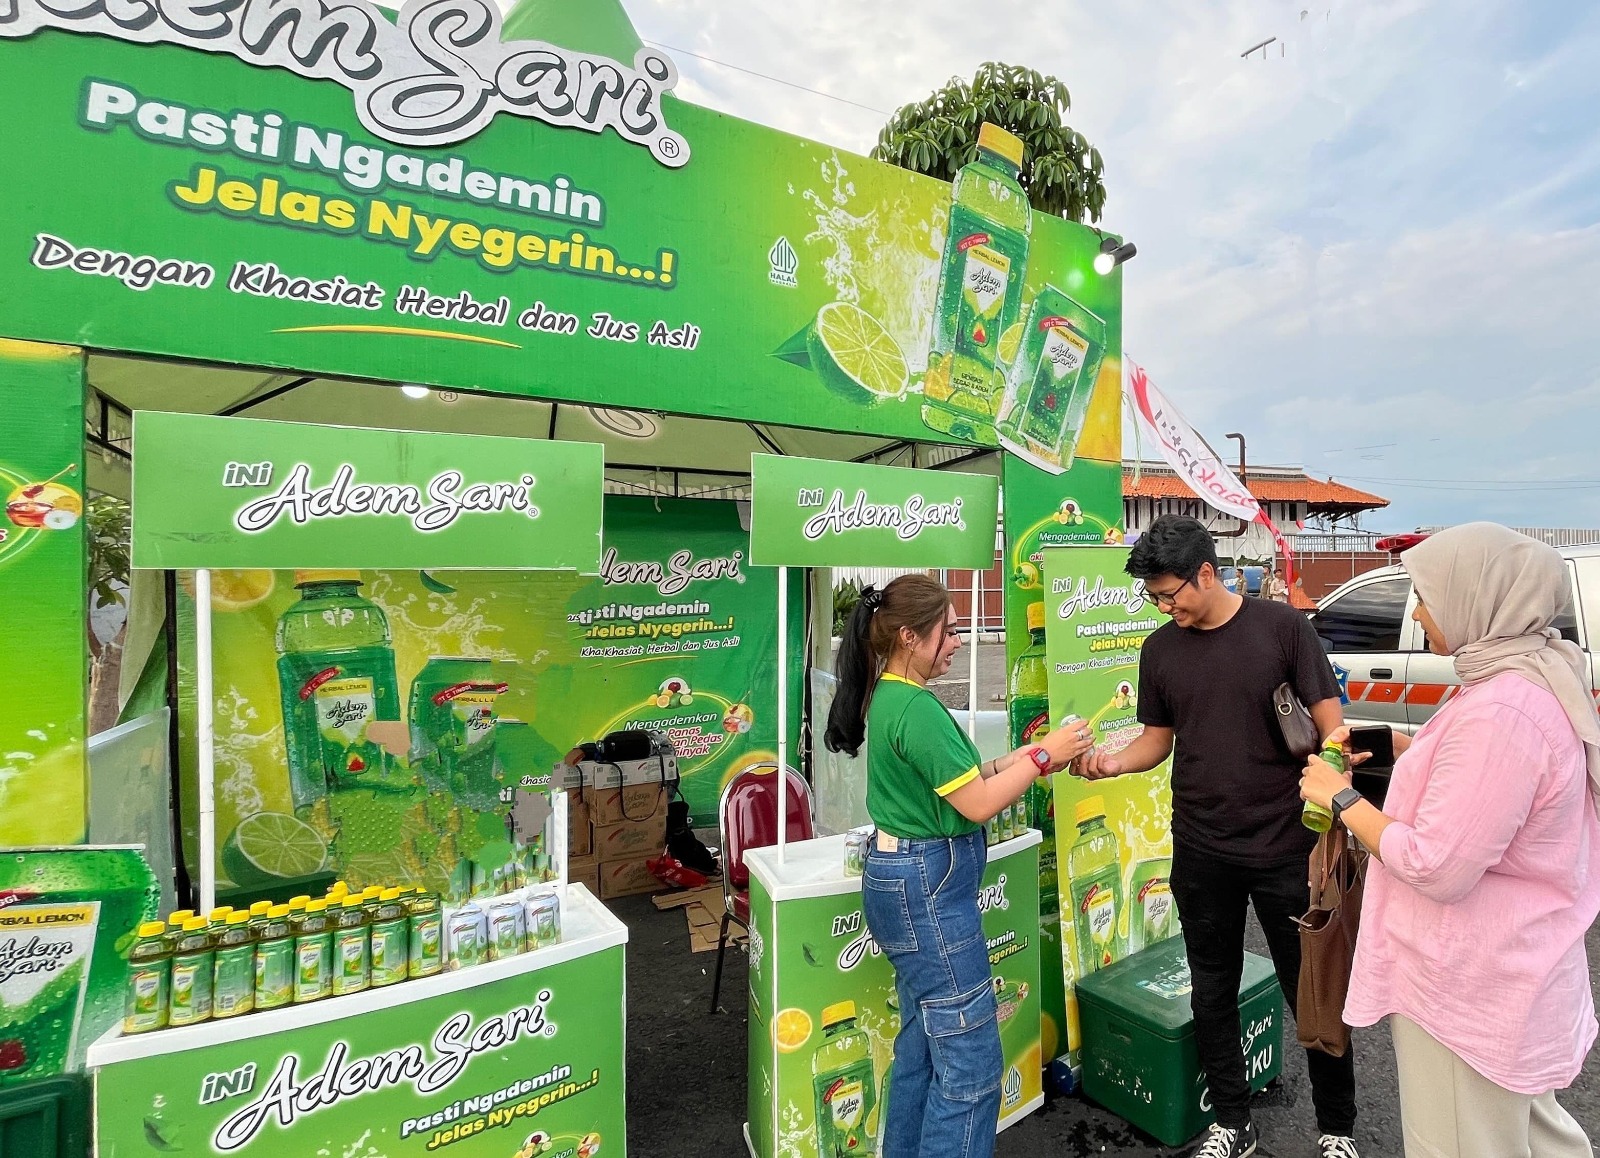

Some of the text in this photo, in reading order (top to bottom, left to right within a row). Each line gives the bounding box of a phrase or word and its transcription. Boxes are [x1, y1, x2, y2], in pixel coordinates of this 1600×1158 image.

[366, 0, 668, 136] Sari
[86, 80, 602, 222] Pasti Ngademin
[174, 168, 674, 283] Jelas Nyegerin...!
[770, 272, 797, 284] HALAL
[34, 236, 699, 350] Dengan Khasiat Herbal dan Jus Asli
[224, 462, 535, 532] iNi Adem Sari
[798, 489, 963, 539] iNi Adem Sari
[1038, 531, 1101, 543] Mengademkan
[658, 550, 744, 595] Sari
[1058, 577, 1129, 619] Adem
[618, 599, 710, 621] Ngademin
[638, 616, 734, 639] Nyegerin...!
[1076, 616, 1158, 638] Pasti Ngademin
[604, 645, 643, 657] Khasiat
[647, 641, 680, 654] Herbal
[682, 641, 700, 651] dan
[703, 638, 721, 650] Jus
[722, 636, 741, 647] Asli
[1089, 637, 1116, 652] Jelas
[1055, 662, 1086, 674] Dengan
[1088, 657, 1114, 669] Khasiat
[325, 700, 368, 720] Adem
[332, 711, 366, 729] Sari
[624, 712, 718, 731] Mengademkan
[667, 726, 701, 738] Panas
[690, 734, 723, 747] Pedas
[0, 912, 86, 927] RBAL LEMON
[833, 911, 862, 936] iNi
[1242, 1008, 1275, 1057] Sari
[202, 990, 553, 1151] iNi Adem Sari
[400, 1064, 571, 1138] Pasti Ngademin
[427, 1068, 599, 1149] Jelas Nyegerin...!
